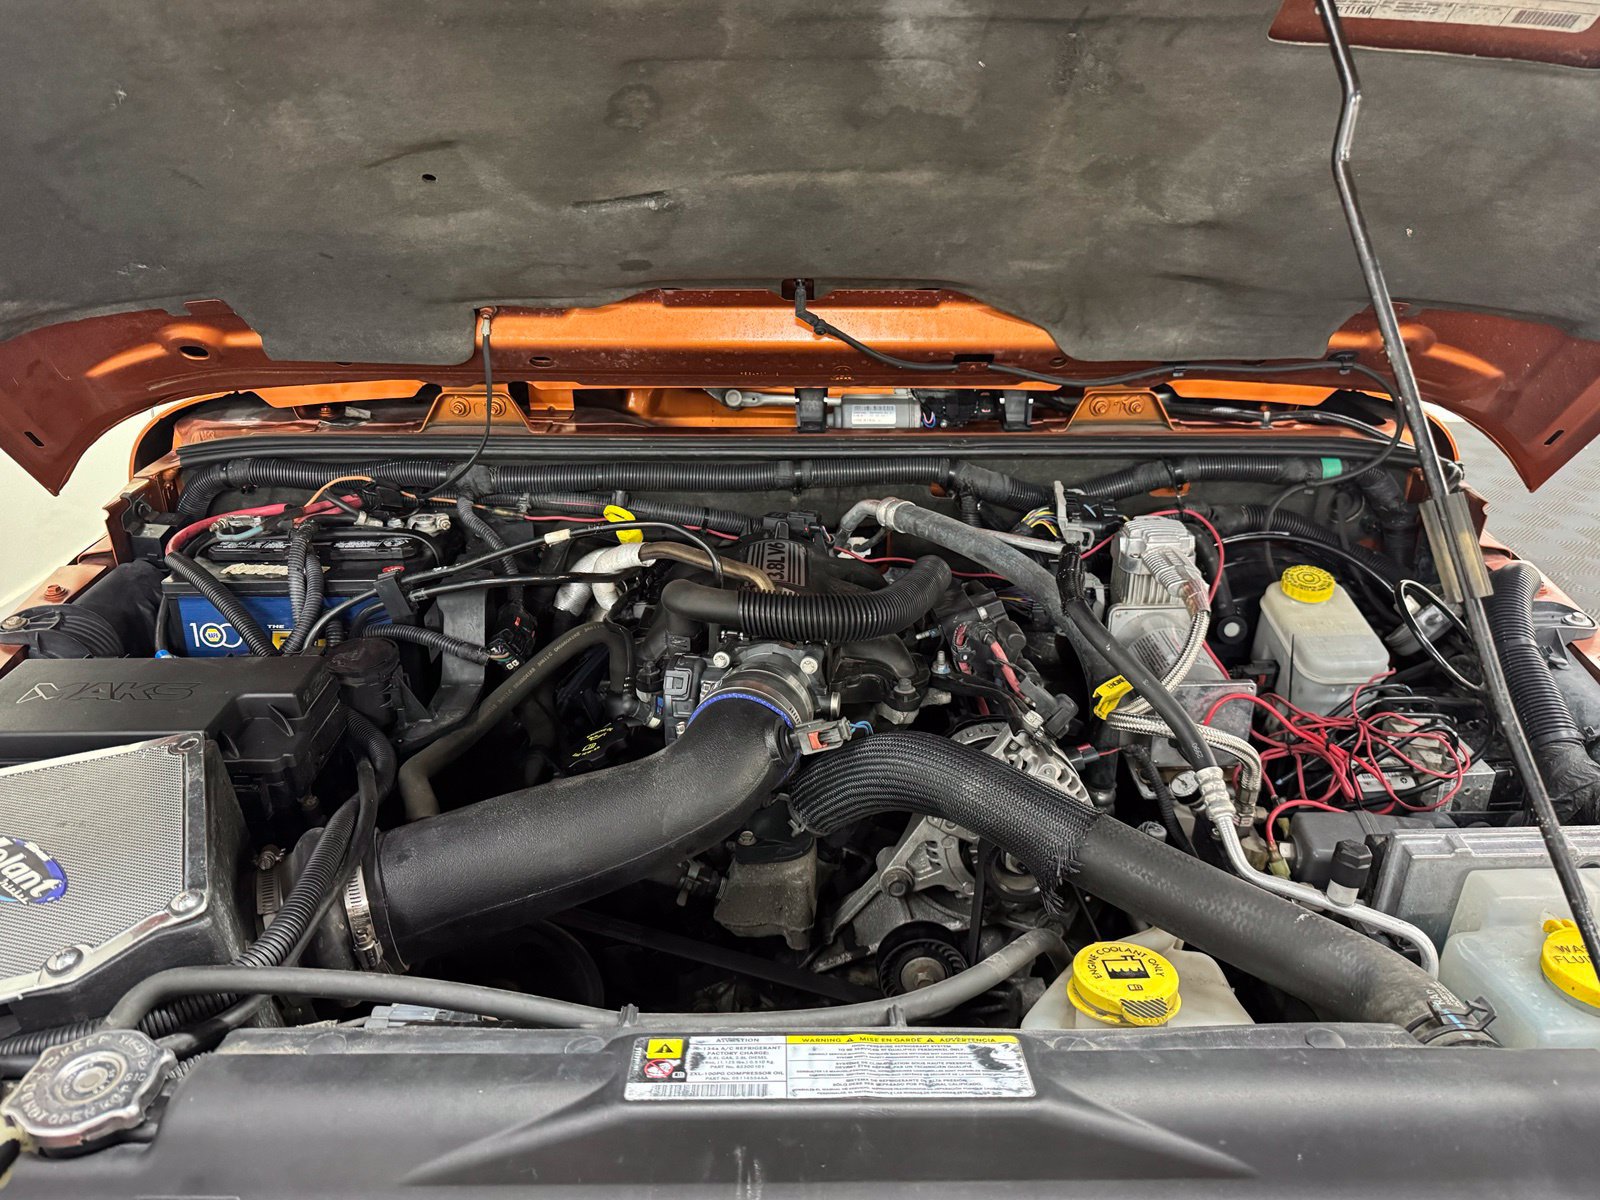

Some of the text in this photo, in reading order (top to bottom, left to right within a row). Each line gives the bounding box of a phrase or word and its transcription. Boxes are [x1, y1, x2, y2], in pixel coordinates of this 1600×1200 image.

[1087, 946, 1165, 980] ENGINE COOLANT ONLY
[1553, 956, 1591, 964] FLUI
